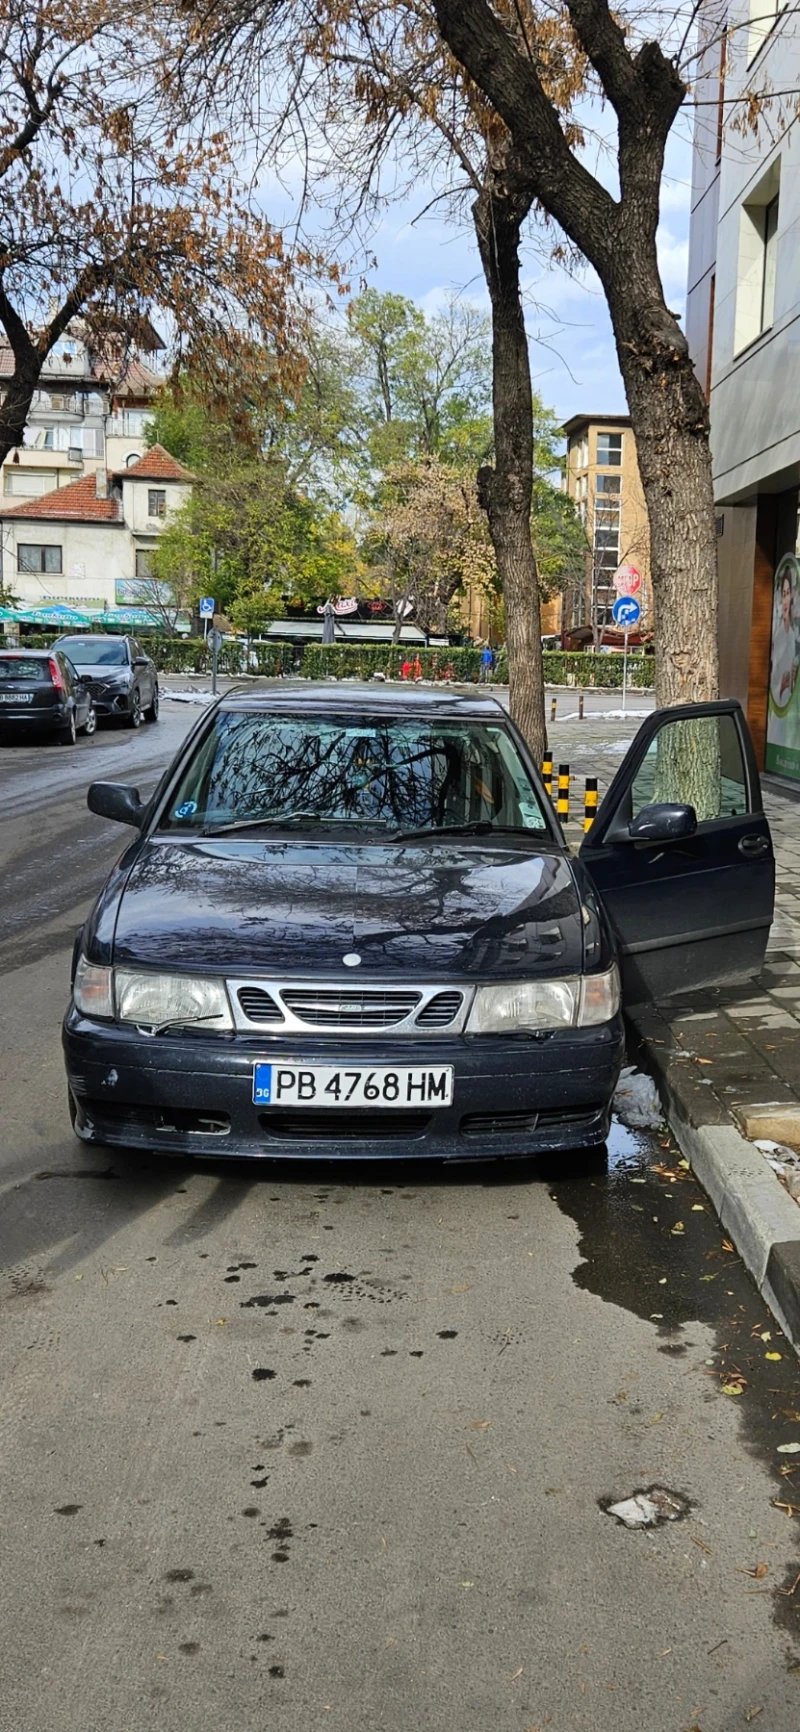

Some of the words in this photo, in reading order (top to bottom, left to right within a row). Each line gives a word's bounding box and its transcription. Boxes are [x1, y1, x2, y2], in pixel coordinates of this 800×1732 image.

[616, 574, 640, 588] STOP
[276, 1070, 316, 1100] PB
[324, 1072, 400, 1101] 4768
[406, 1072, 447, 1101] HM
